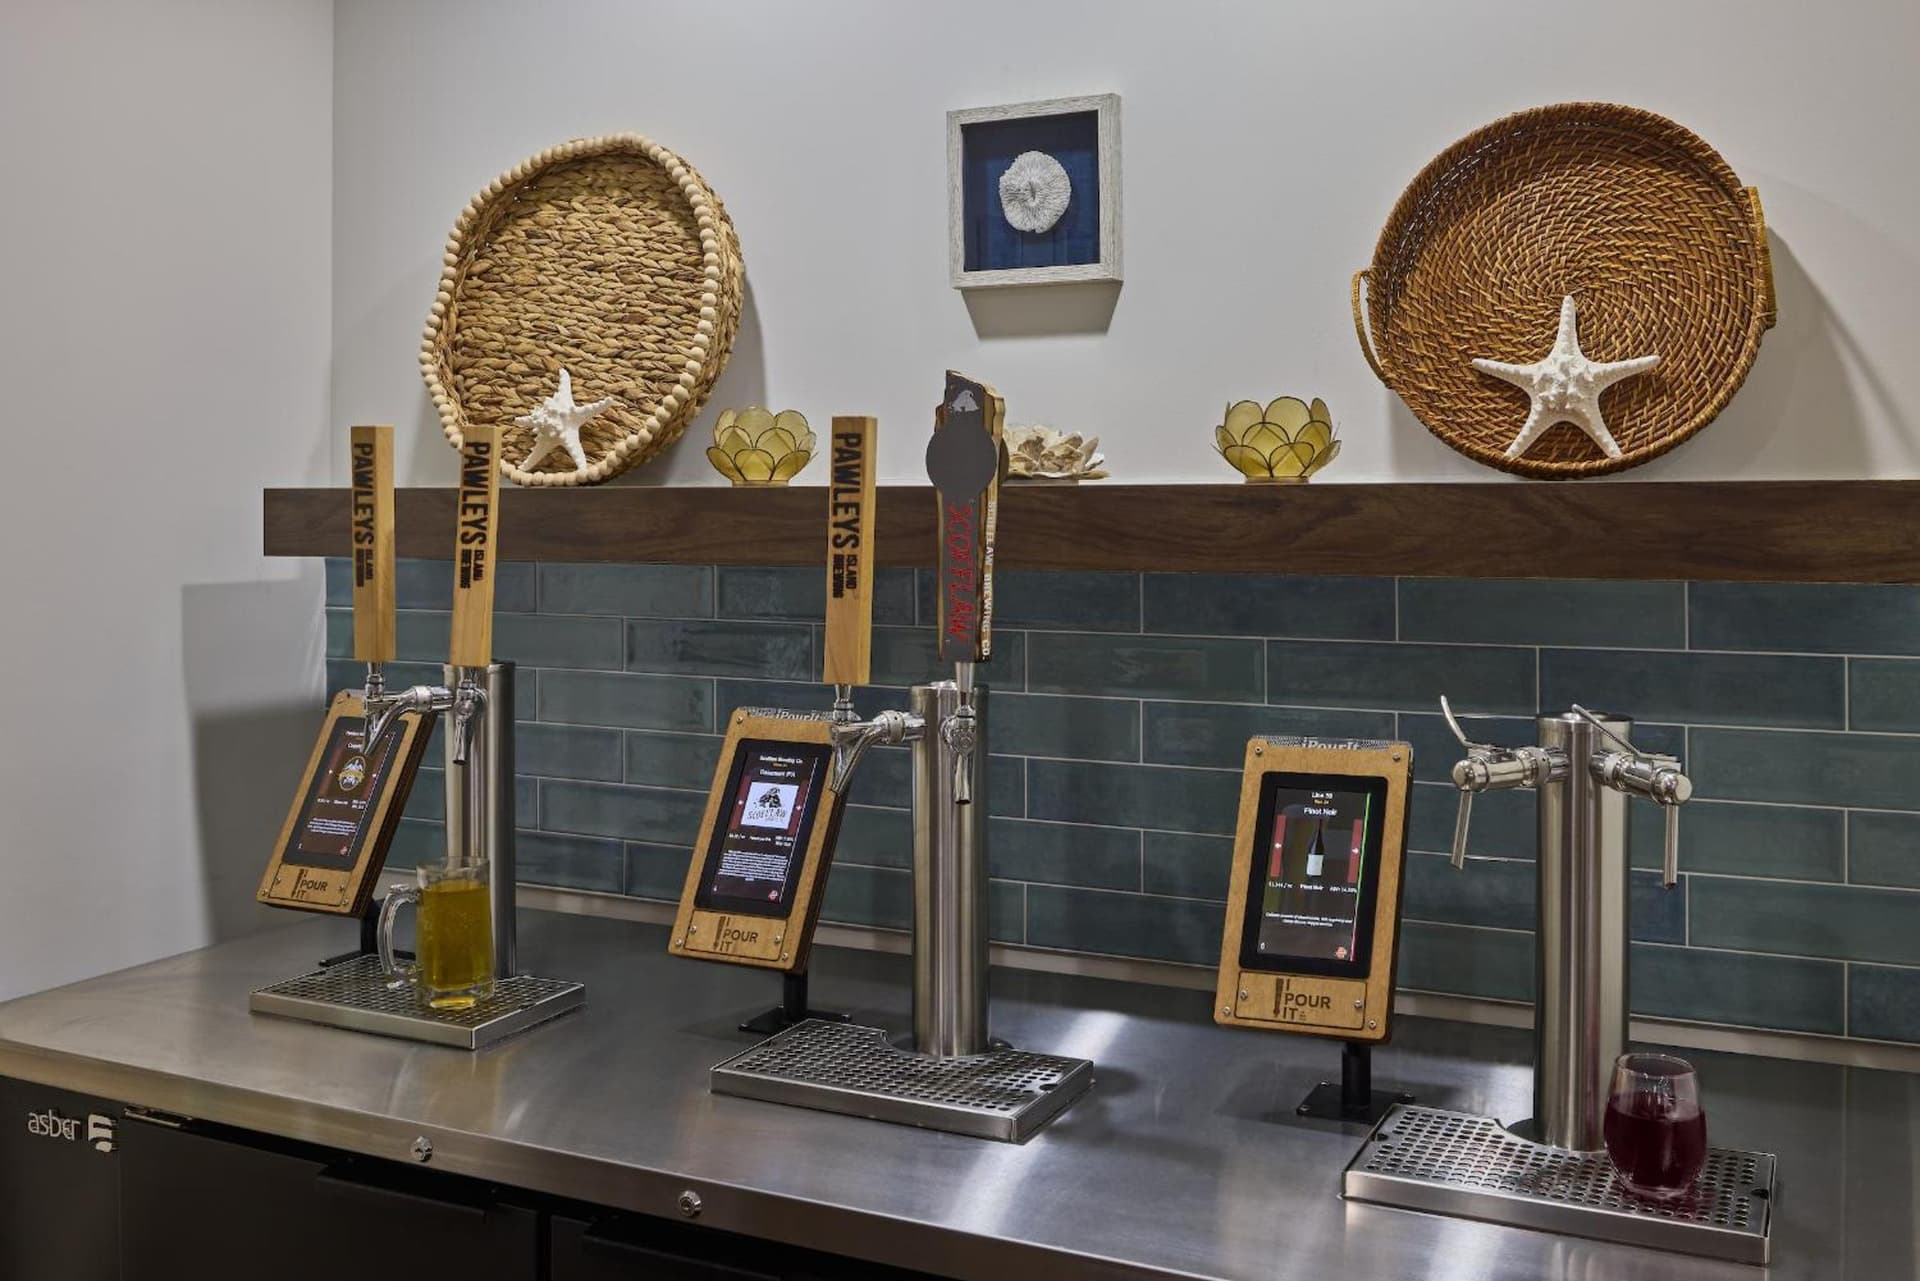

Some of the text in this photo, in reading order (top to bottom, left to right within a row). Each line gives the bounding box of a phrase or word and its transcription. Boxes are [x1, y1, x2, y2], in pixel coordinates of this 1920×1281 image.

[353, 442, 374, 545] PAWLEYS
[460, 441, 490, 545] PAWLEYS
[832, 432, 862, 549] PAWLEYS
[1304, 807, 1322, 816] Pinot
[300, 879, 328, 891] POUR
[723, 929, 759, 943] POUR
[720, 941, 733, 952] IT
[1284, 992, 1331, 1010] POUR
[1283, 1007, 1298, 1020] IT
[28, 1109, 81, 1141] asber
